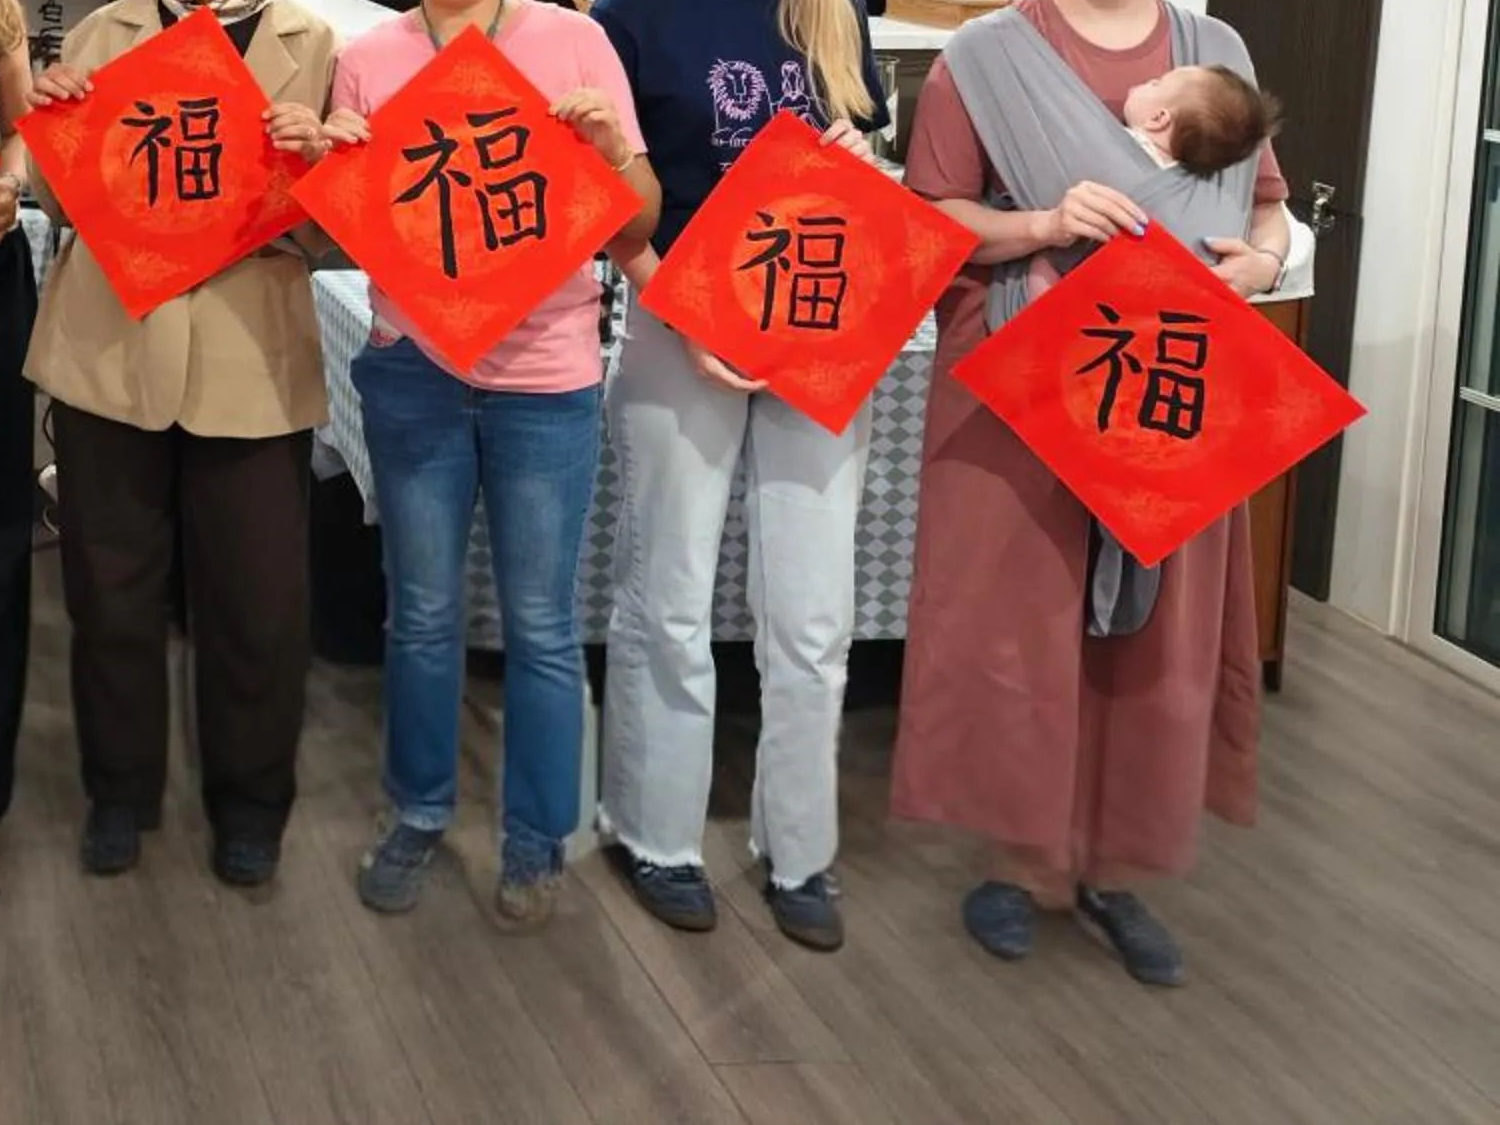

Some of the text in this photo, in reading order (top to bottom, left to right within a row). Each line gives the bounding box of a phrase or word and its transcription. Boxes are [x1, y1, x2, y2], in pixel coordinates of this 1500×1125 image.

[121, 97, 223, 207] 福
[396, 106, 549, 280] 福
[737, 211, 848, 332] 福
[1074, 302, 1209, 441] 福
